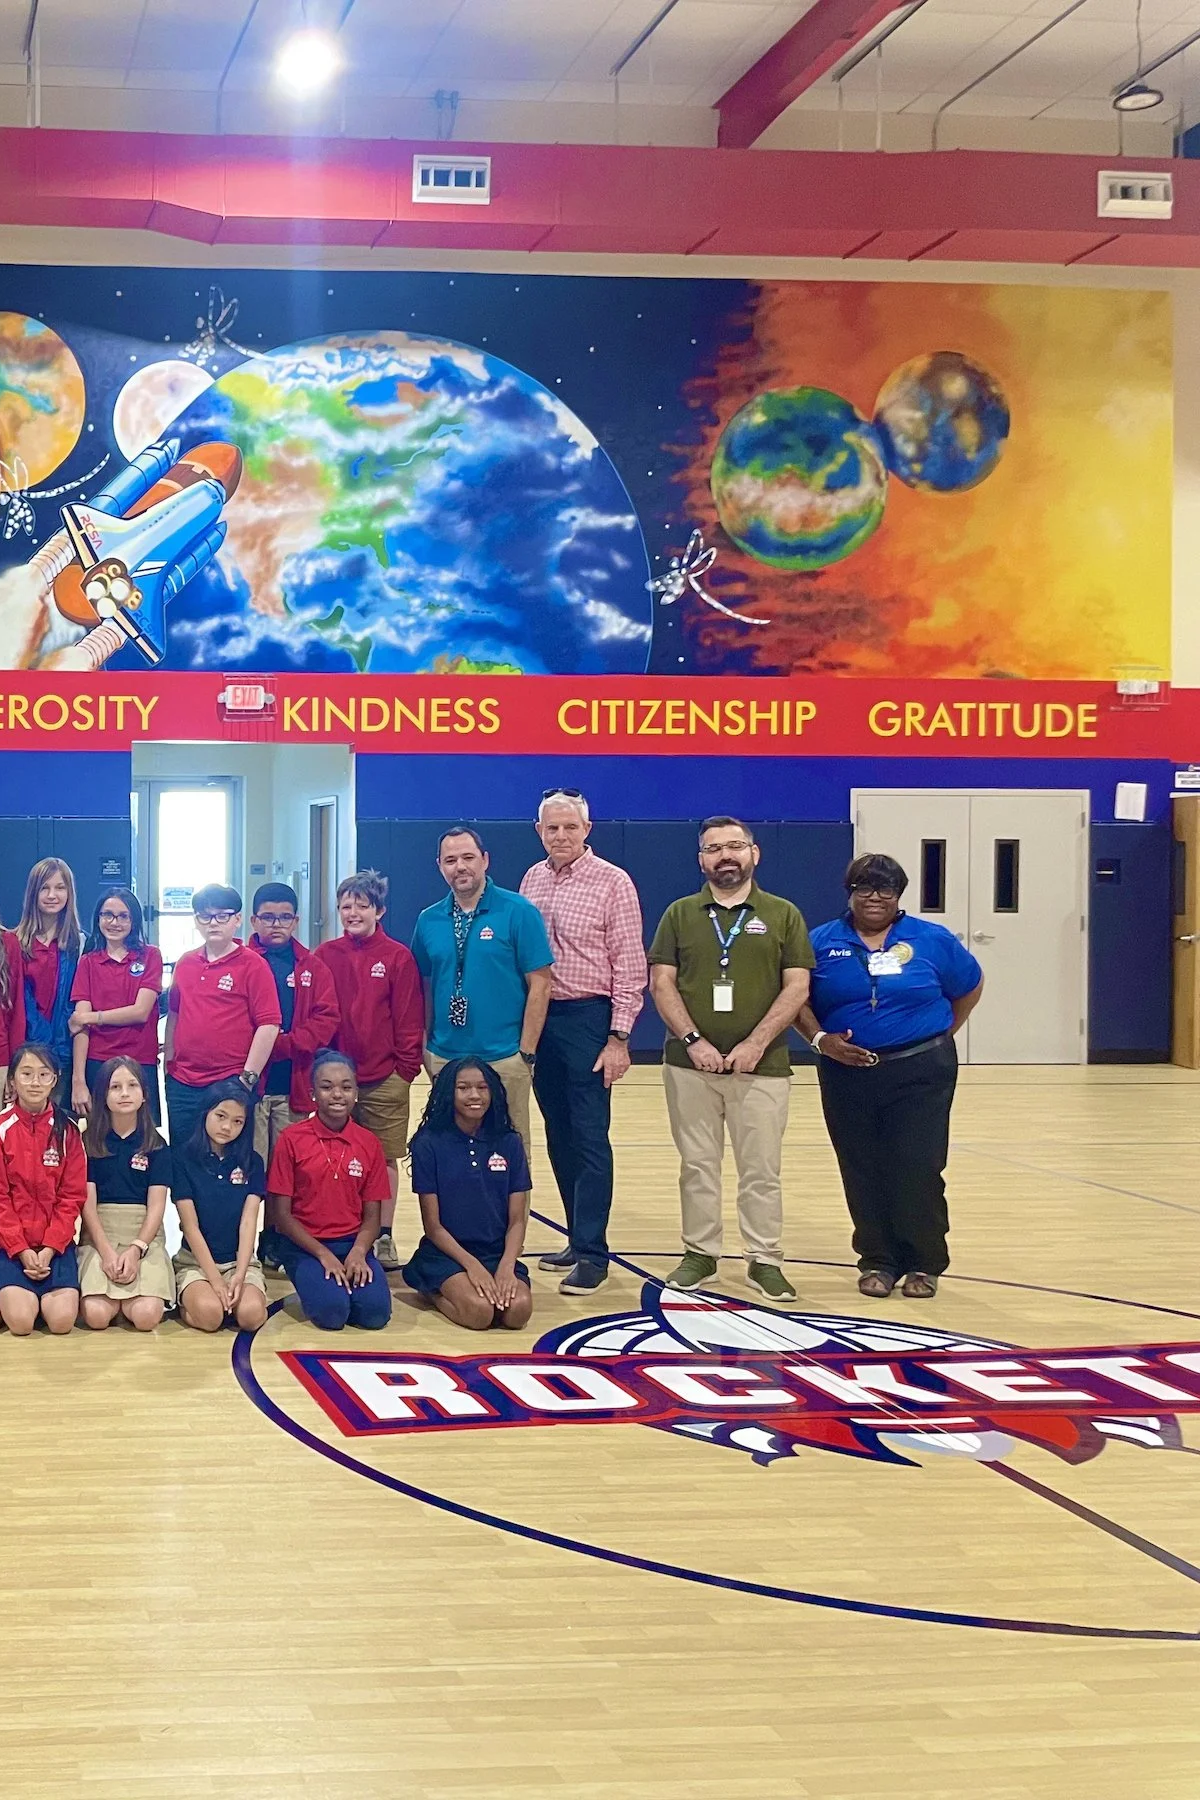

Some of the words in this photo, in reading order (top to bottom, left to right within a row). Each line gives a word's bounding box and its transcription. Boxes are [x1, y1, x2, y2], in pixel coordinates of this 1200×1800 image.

[233, 687, 260, 707] EXIT
[283, 697, 501, 734] KINDNESS
[557, 699, 817, 736] CITIZENSHIP
[868, 701, 1099, 739] GRATITUDE
[829, 948, 852, 958] Avis
